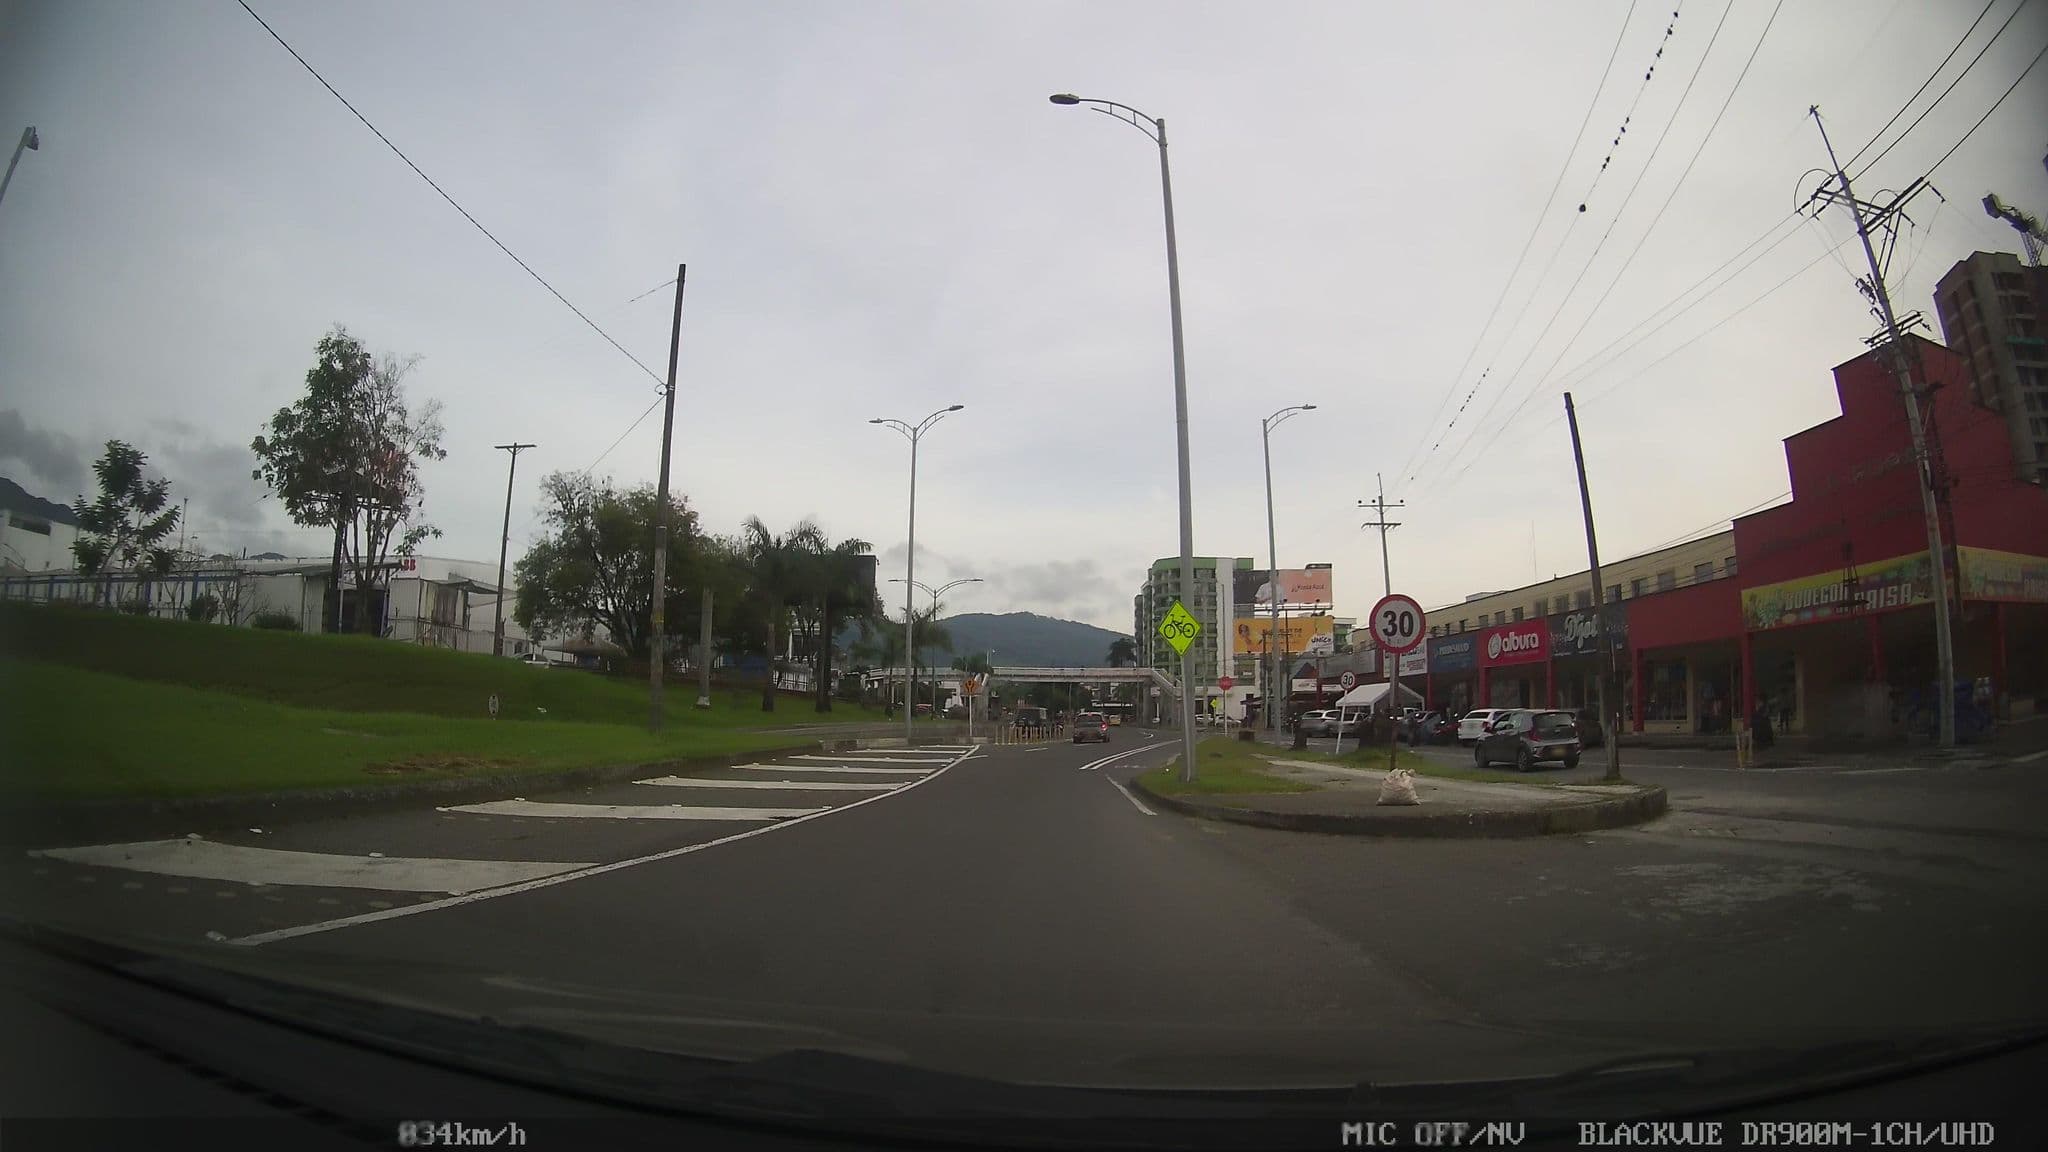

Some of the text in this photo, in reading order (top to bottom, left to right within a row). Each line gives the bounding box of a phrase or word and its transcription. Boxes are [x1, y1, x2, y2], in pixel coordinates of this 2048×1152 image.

[1382, 610, 1414, 637] 30
[1502, 631, 1540, 652] albura
[1342, 674, 1354, 686] 30
